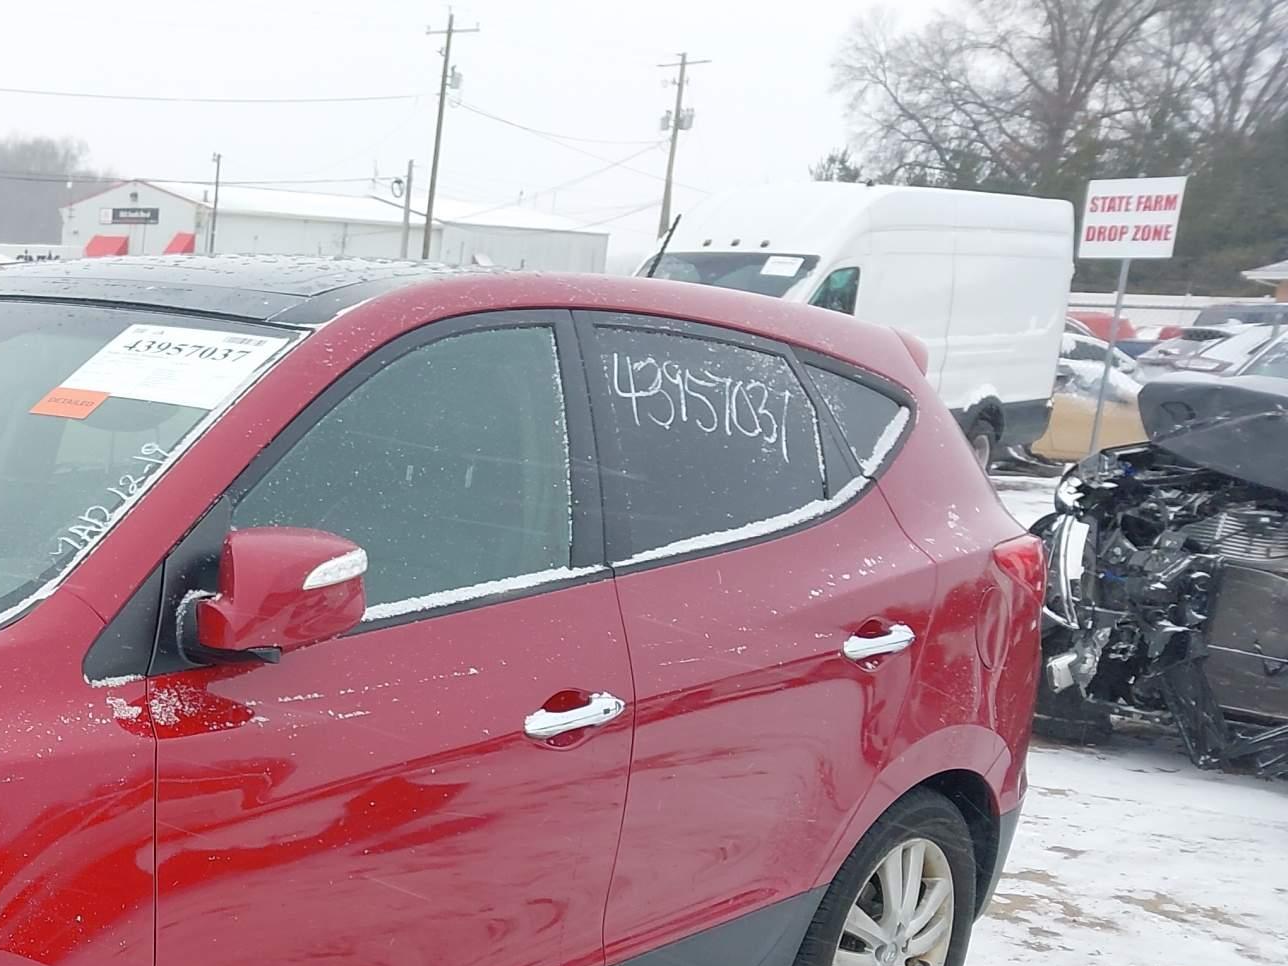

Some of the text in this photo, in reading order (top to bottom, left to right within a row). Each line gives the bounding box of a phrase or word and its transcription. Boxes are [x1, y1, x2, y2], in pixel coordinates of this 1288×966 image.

[1090, 194, 1178, 213] STATE FARM
[1085, 225, 1173, 242] DROP ZONE
[123, 338, 252, 362] 43957037
[613, 352, 792, 463] 43957037
